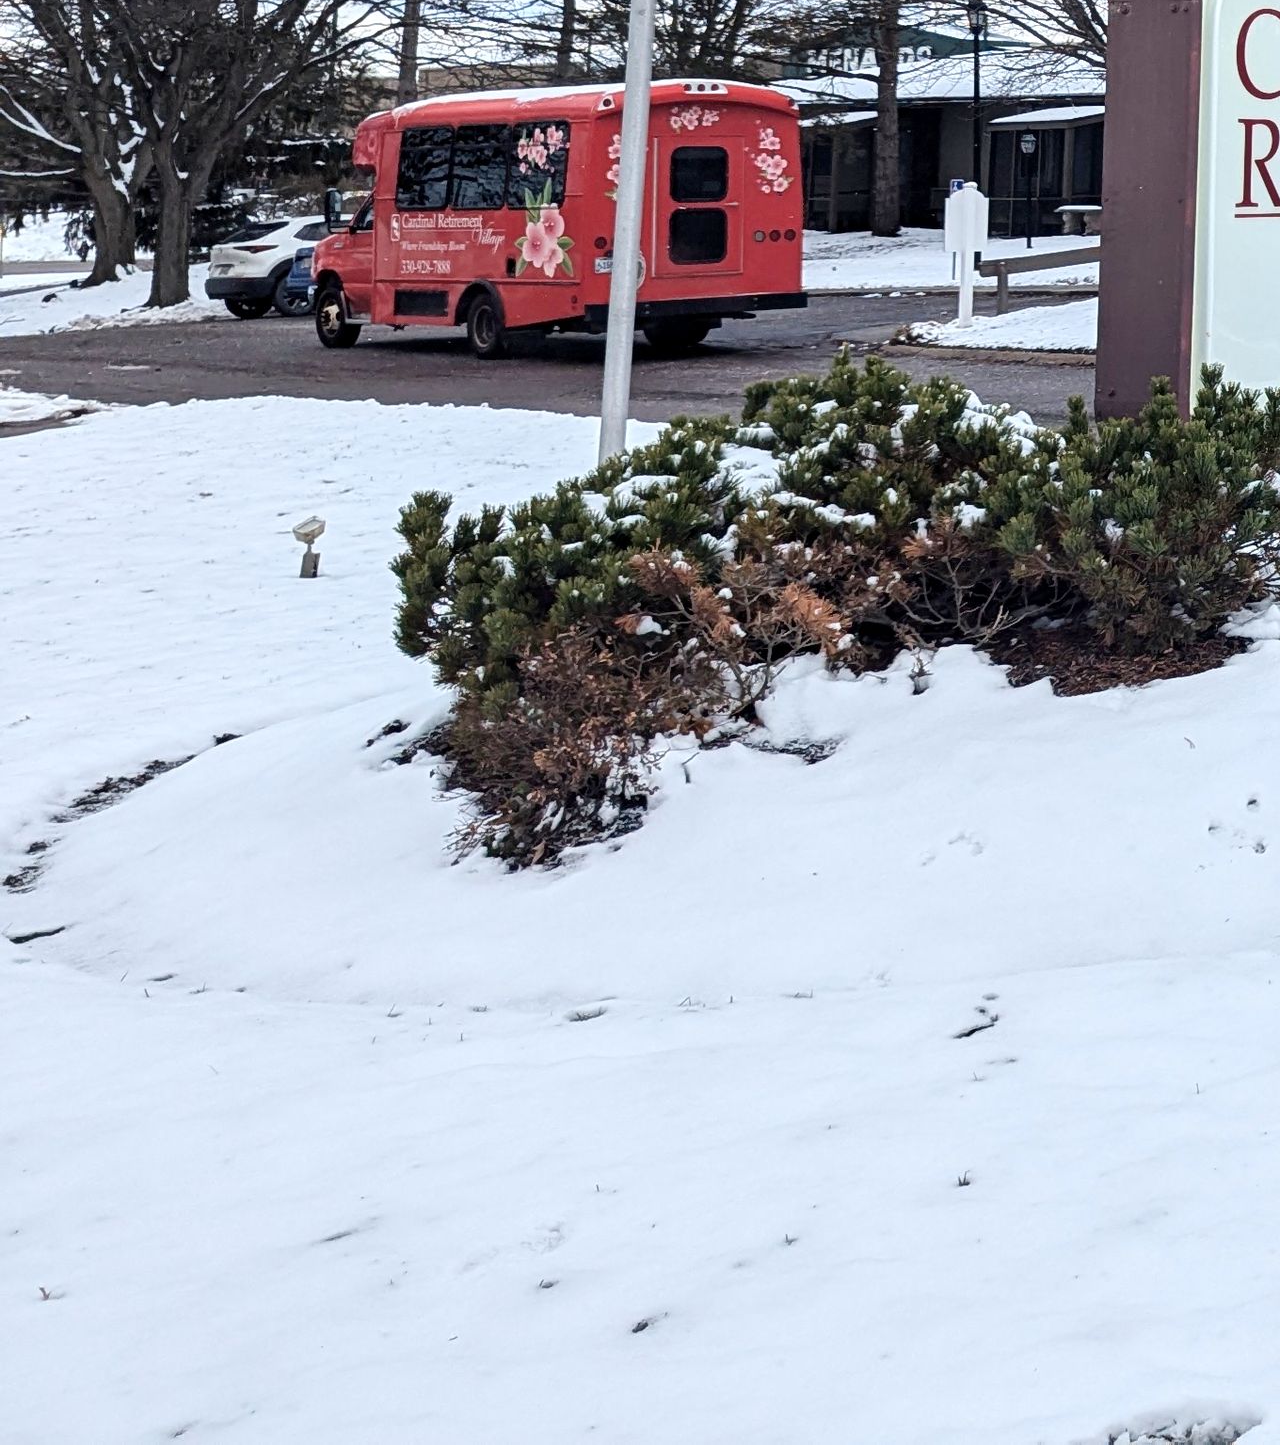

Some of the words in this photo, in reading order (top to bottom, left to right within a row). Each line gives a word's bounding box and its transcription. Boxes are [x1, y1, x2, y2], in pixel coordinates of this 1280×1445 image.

[806, 46, 932, 73] MENADS
[402, 214, 436, 228] Cardinal
[438, 214, 483, 228] Retirement
[472, 221, 506, 255] Village
